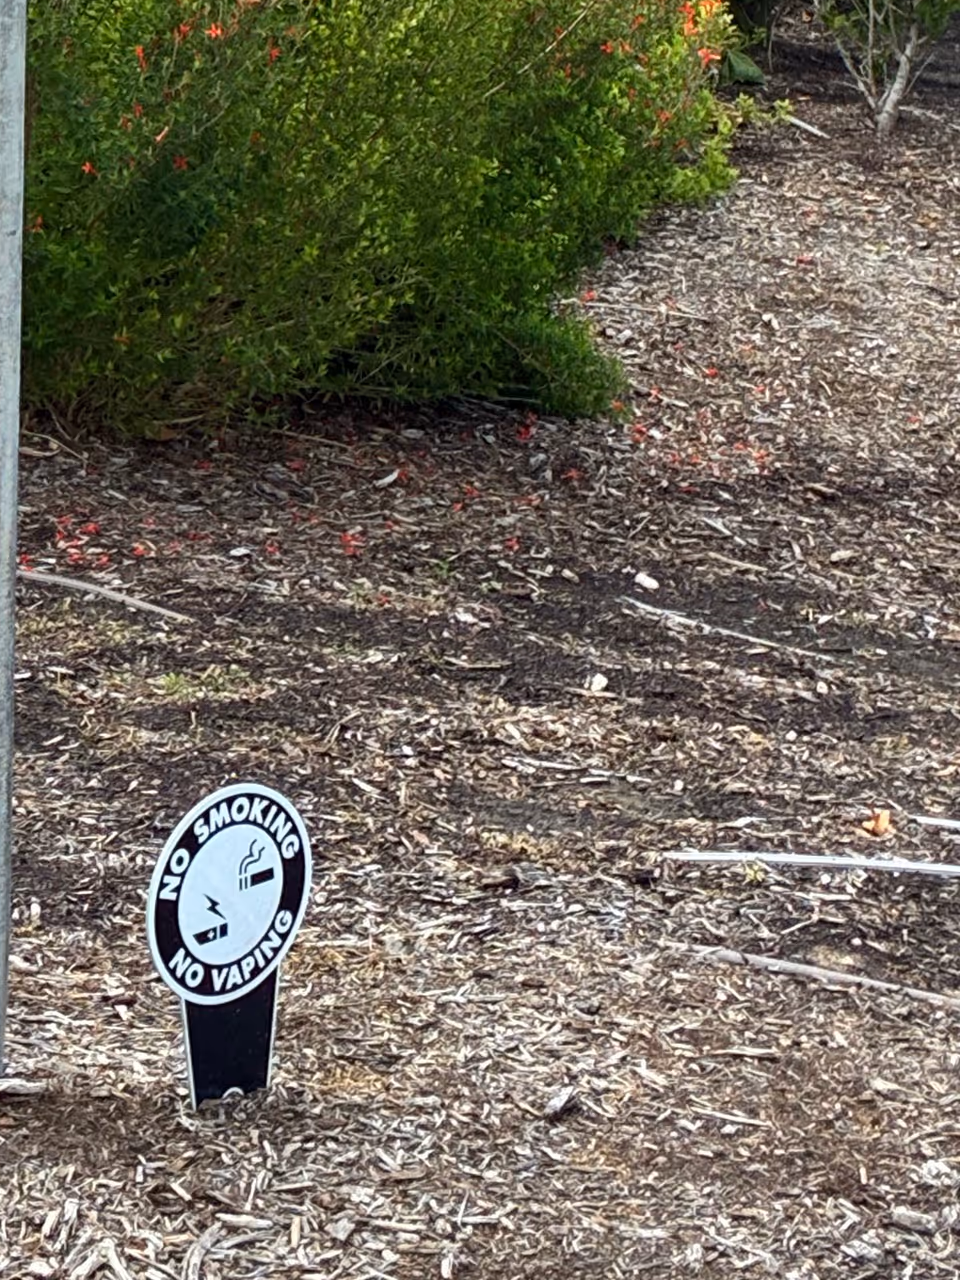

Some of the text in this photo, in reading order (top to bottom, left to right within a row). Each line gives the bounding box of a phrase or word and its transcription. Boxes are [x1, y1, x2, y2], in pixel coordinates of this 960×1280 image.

[159, 797, 299, 900] NO SMOKING
[169, 910, 293, 991] NO VAPING
